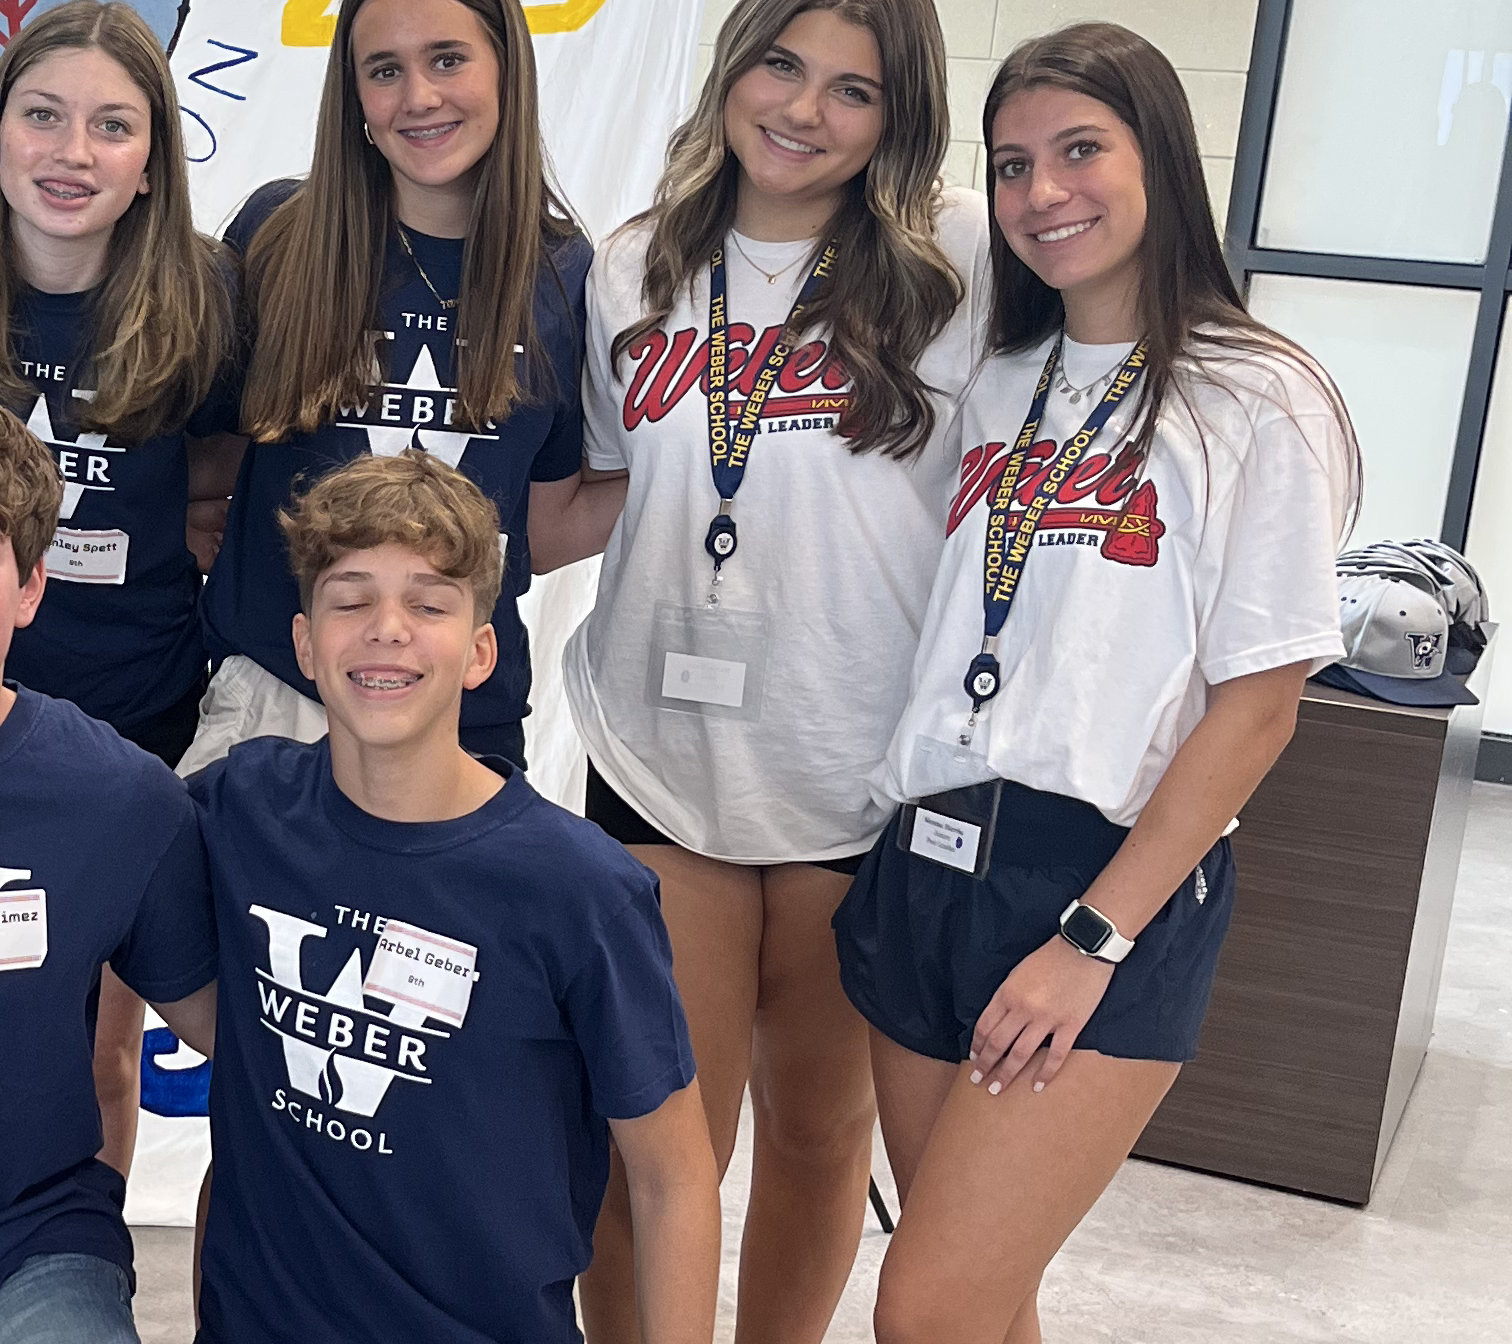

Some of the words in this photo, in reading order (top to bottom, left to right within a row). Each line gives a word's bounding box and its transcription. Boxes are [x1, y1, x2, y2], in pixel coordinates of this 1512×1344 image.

[401, 312, 448, 332] THE
[710, 293, 724, 329] THE
[21, 360, 66, 381] THE
[709, 329, 726, 389] WEBER
[1104, 369, 1134, 404] THE
[709, 390, 728, 467] SCHOOL
[727, 431, 751, 468] THE
[740, 369, 778, 433] WEBER
[767, 416, 835, 435] LEADER
[1016, 419, 1038, 450] THE
[992, 451, 1026, 511] WEBER
[992, 564, 1020, 603] THE
[1007, 495, 1047, 564] WEBER
[1042, 426, 1098, 495] SCHOOL
[51, 538, 80, 553] nley
[82, 542, 118, 554] Spett
[985, 513, 1006, 594] SCHOOL
[1037, 533, 1099, 548] LEADER
[333, 903, 387, 935] THE
[378, 937, 421, 962] Arbel
[424, 951, 471, 978] Geber
[257, 980, 427, 1072] WEBER
[271, 1088, 394, 1155] SCHOOL
